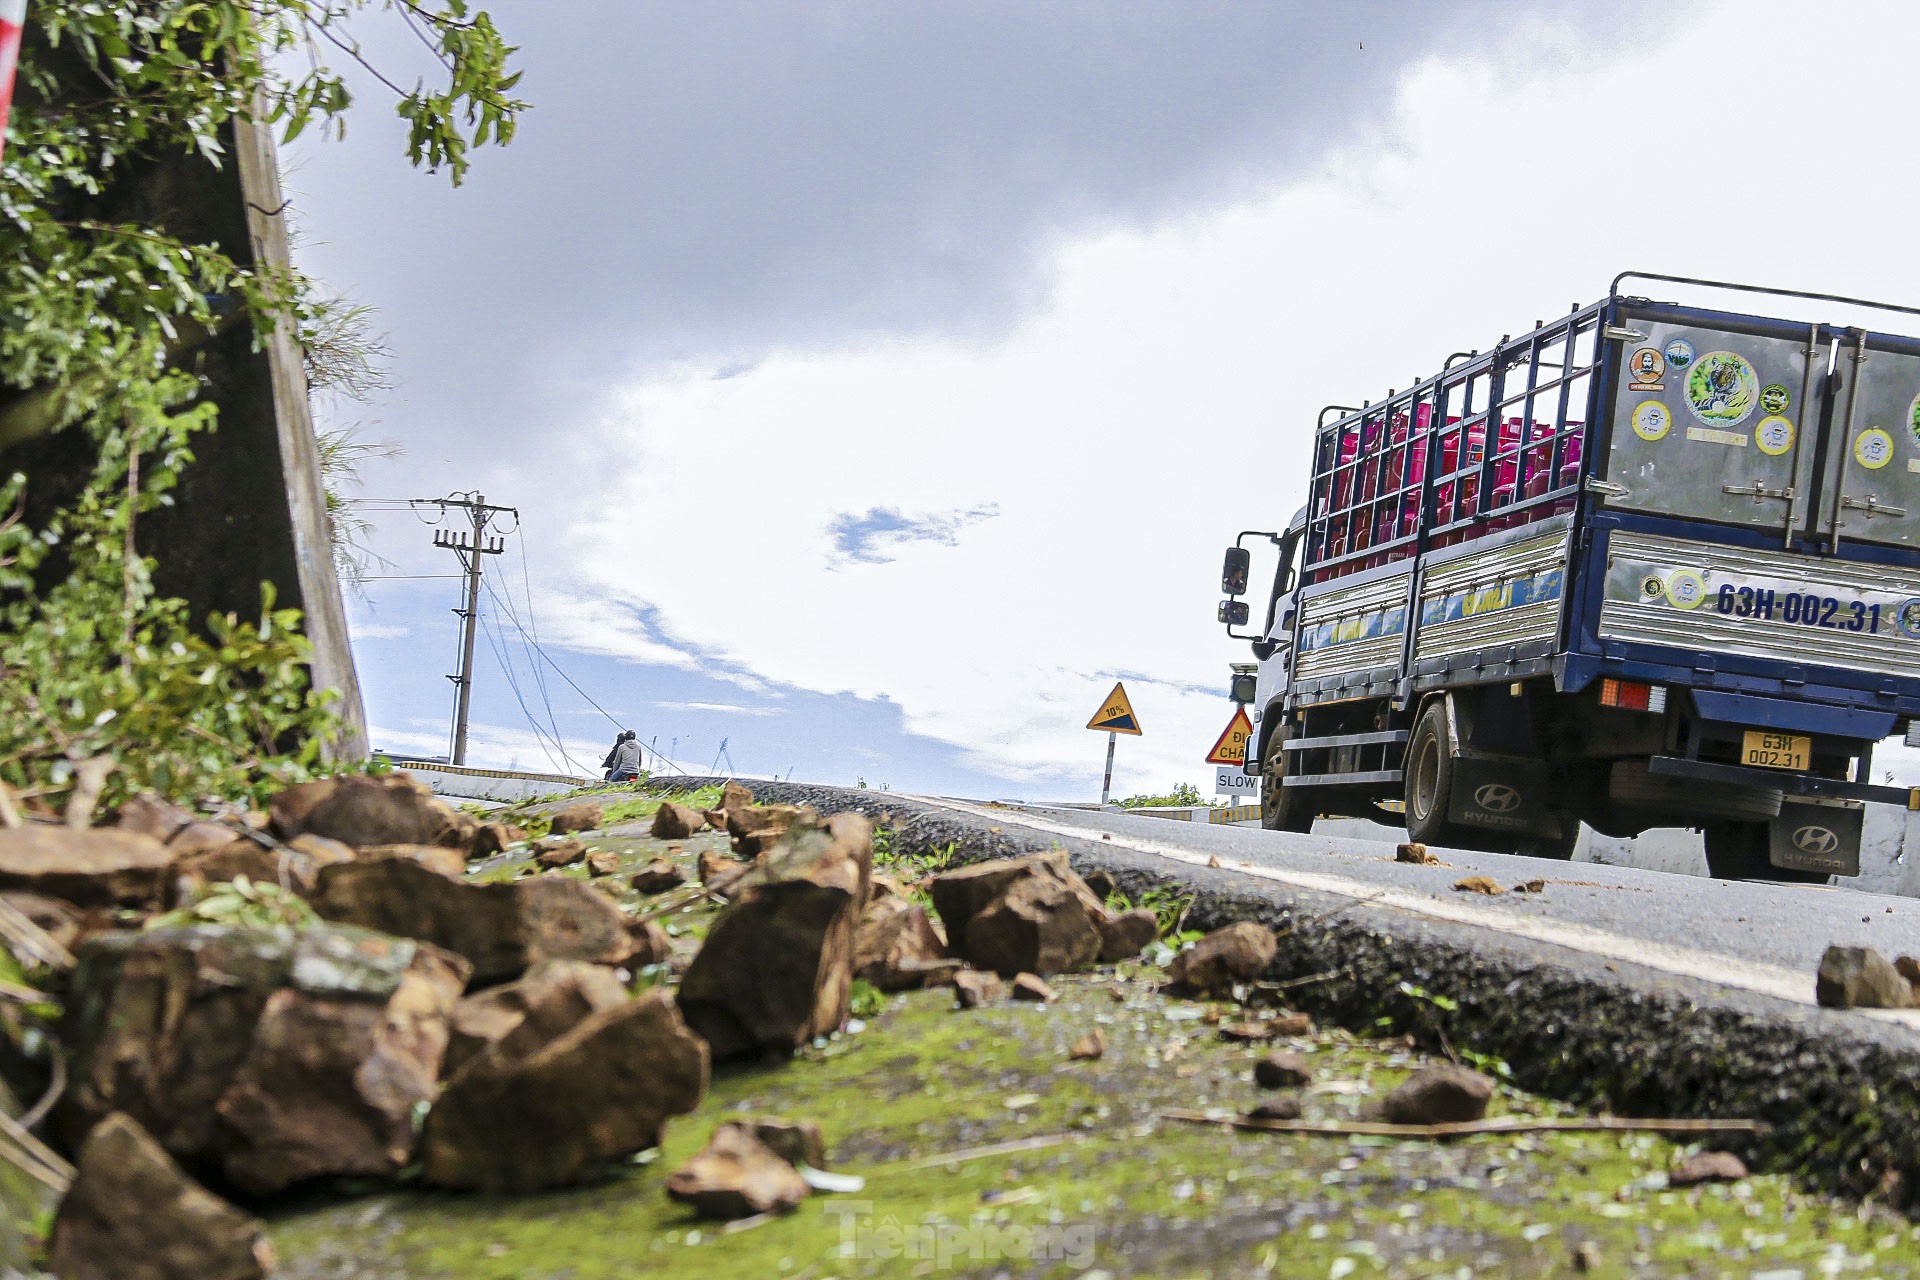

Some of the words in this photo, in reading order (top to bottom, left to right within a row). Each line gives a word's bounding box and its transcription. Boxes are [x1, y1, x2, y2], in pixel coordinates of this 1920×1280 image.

[1717, 584, 1880, 633] 63H-002.31
[1106, 705, 1124, 718] 10%
[1763, 735, 1792, 751] 63H
[1220, 746, 1244, 758] CHÂ
[1749, 749, 1800, 768] 002.31
[1219, 774, 1256, 788] SLOW
